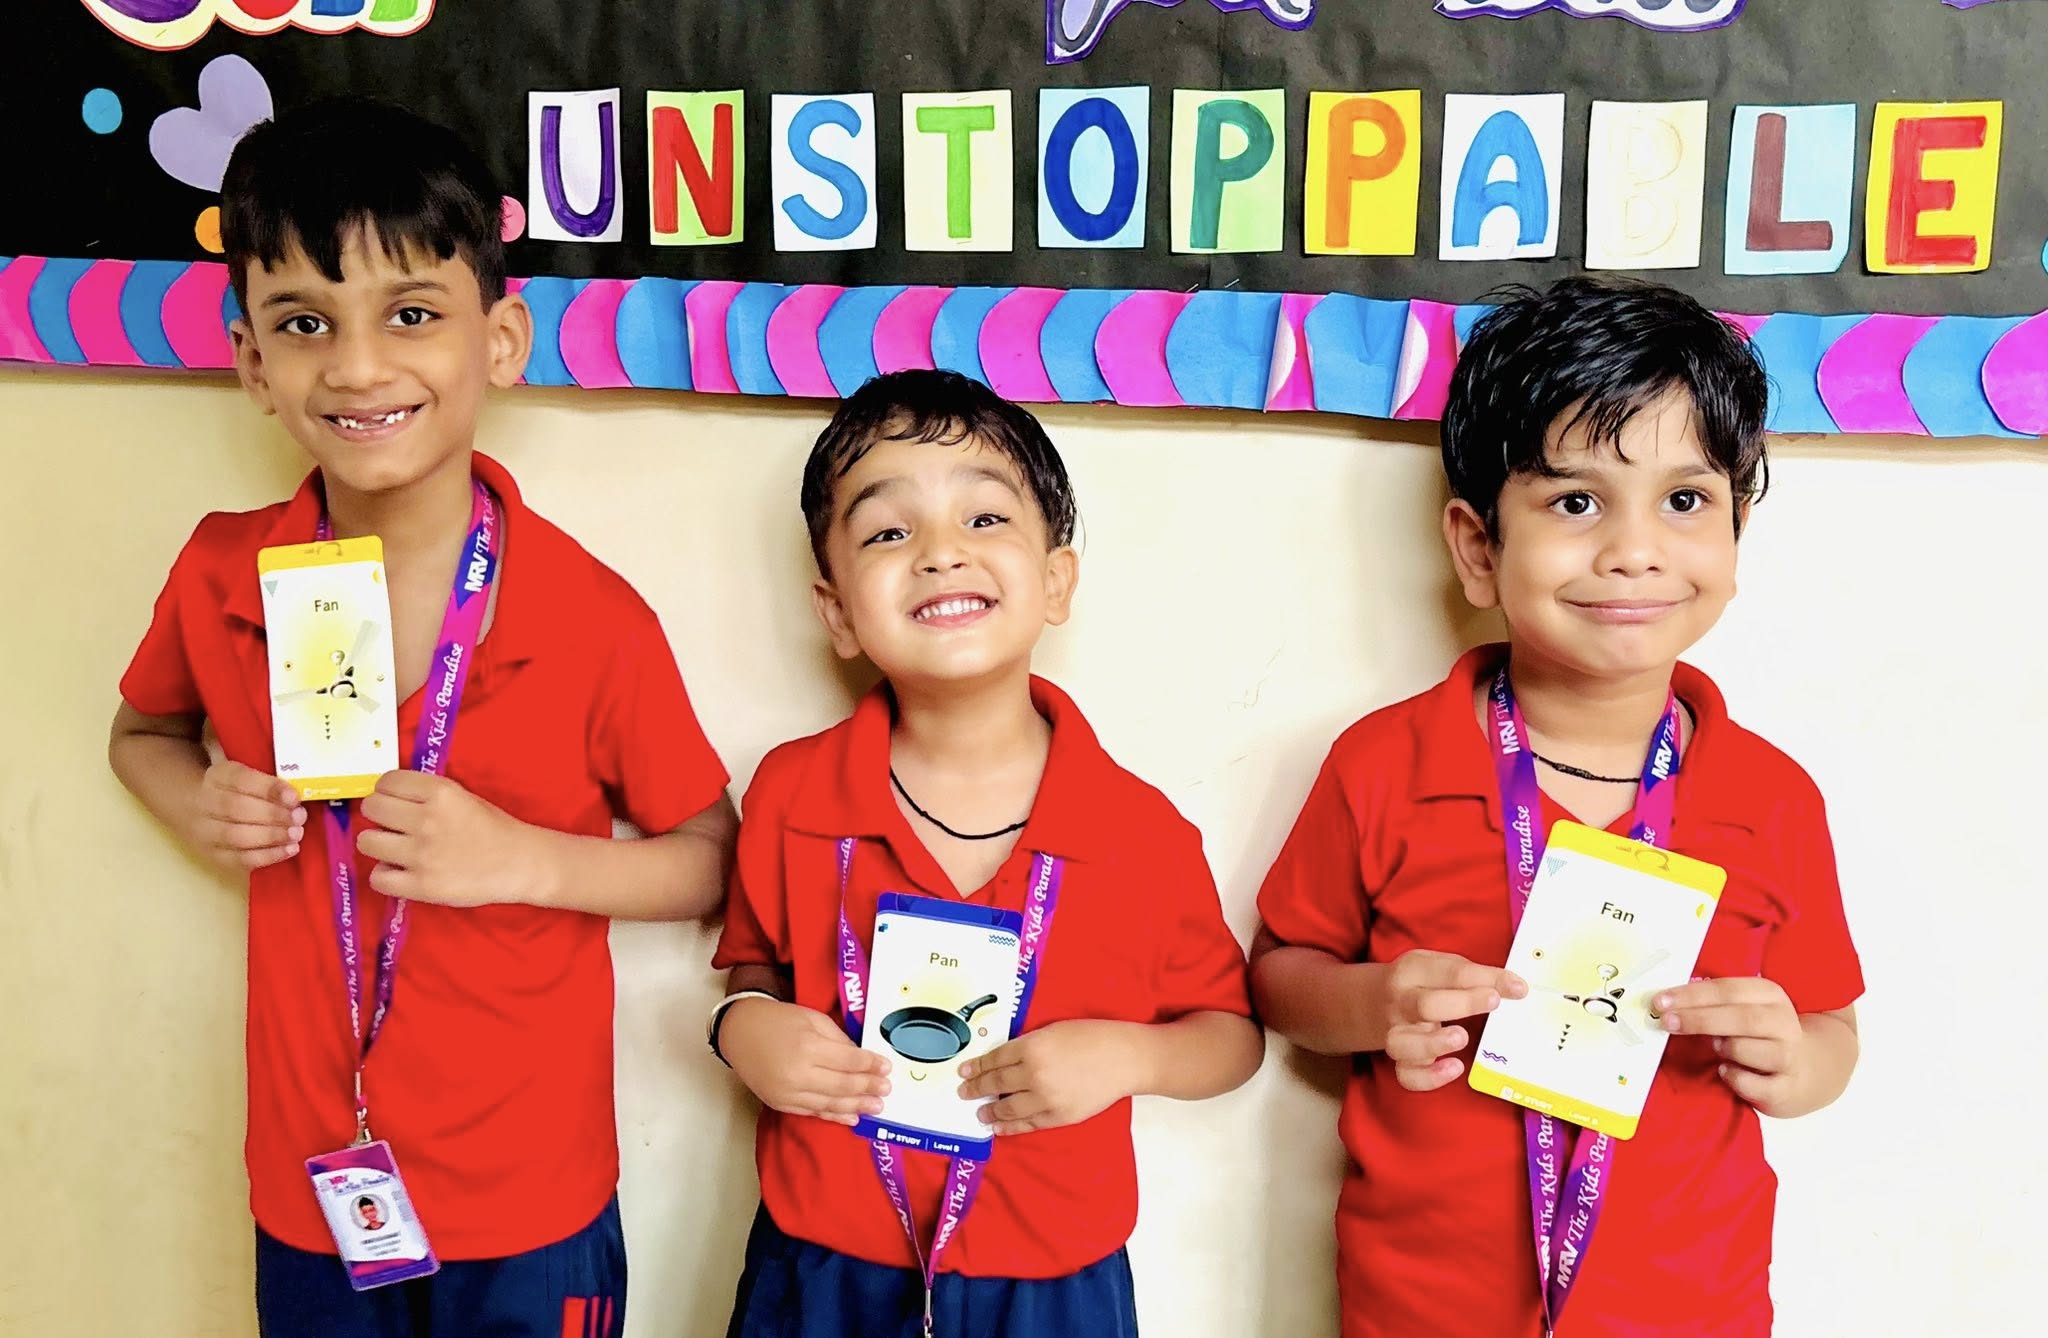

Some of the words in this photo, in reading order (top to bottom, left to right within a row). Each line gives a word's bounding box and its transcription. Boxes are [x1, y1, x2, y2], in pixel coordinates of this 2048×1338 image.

[540, 97, 1988, 266] UNSTOPPABLE
[475, 528, 493, 552] The
[464, 551, 489, 593] MRV
[314, 600, 339, 612] Fan
[435, 643, 464, 707] Paradise
[1494, 692, 1509, 720] The
[427, 711, 447, 747] Kids
[1497, 720, 1520, 755] MRV
[420, 750, 439, 776] The
[1651, 738, 1673, 781] MRV
[1512, 805, 1534, 878] Paradise
[335, 862, 353, 927] Paradise
[1025, 904, 1044, 944] Kids
[1601, 901, 1635, 924] Fan
[842, 939, 856, 970] The
[930, 952, 959, 968] Pan
[1016, 945, 1035, 975] The
[843, 971, 865, 1012] MRV
[896, 1134, 921, 1146] STUDY
[933, 1141, 952, 1152] Level
[1536, 1154, 1557, 1195] Kids
[1577, 1164, 1601, 1209] Kids
[949, 1182, 967, 1214] The
[1540, 1200, 1554, 1233] The
[1567, 1211, 1590, 1242] The
[1556, 1238, 1579, 1289] MRV
